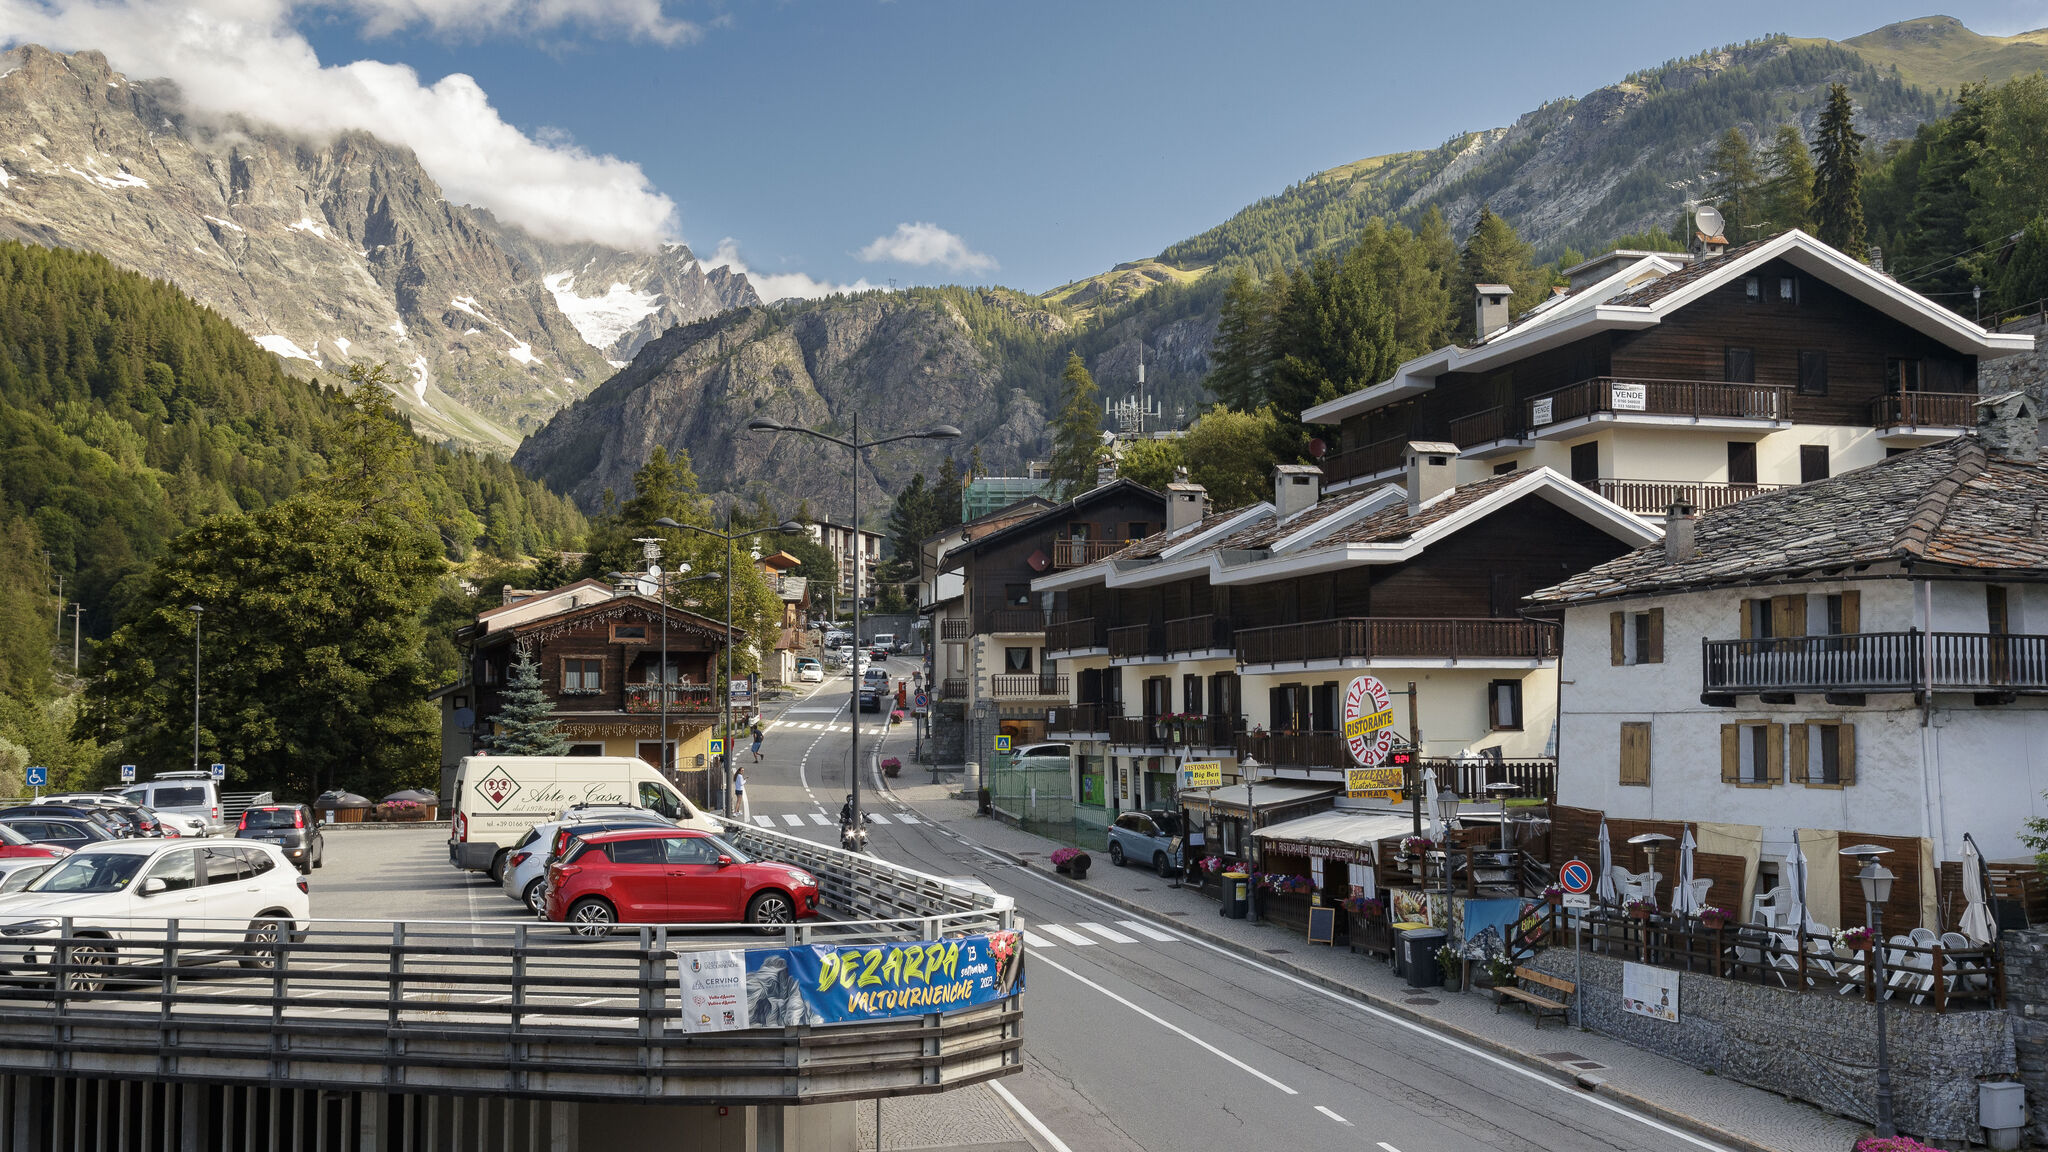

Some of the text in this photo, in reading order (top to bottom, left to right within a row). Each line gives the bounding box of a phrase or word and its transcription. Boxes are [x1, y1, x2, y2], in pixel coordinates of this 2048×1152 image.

[1615, 391, 1643, 399] VENDE
[1534, 405, 1550, 414] VENDE
[1346, 677, 1390, 719] PIZZERIA
[1346, 711, 1392, 737] RISTORANTE
[1349, 730, 1391, 765] BIBLOS
[1184, 763, 1219, 771] RISTORANTE
[1349, 769, 1394, 781] PIZZERIA
[522, 782, 623, 803] Arte e Casa
[1351, 790, 1389, 798] ENTRATA
[1278, 842, 1355, 859] RISTORANTE BIBLOS PIZZERIA
[817, 942, 960, 992] DEZARPA
[960, 963, 988, 977] settembre
[705, 976, 739, 986] CERVINO
[980, 976, 993, 988] 2023
[848, 979, 975, 1013] VALTOURNENCHE
